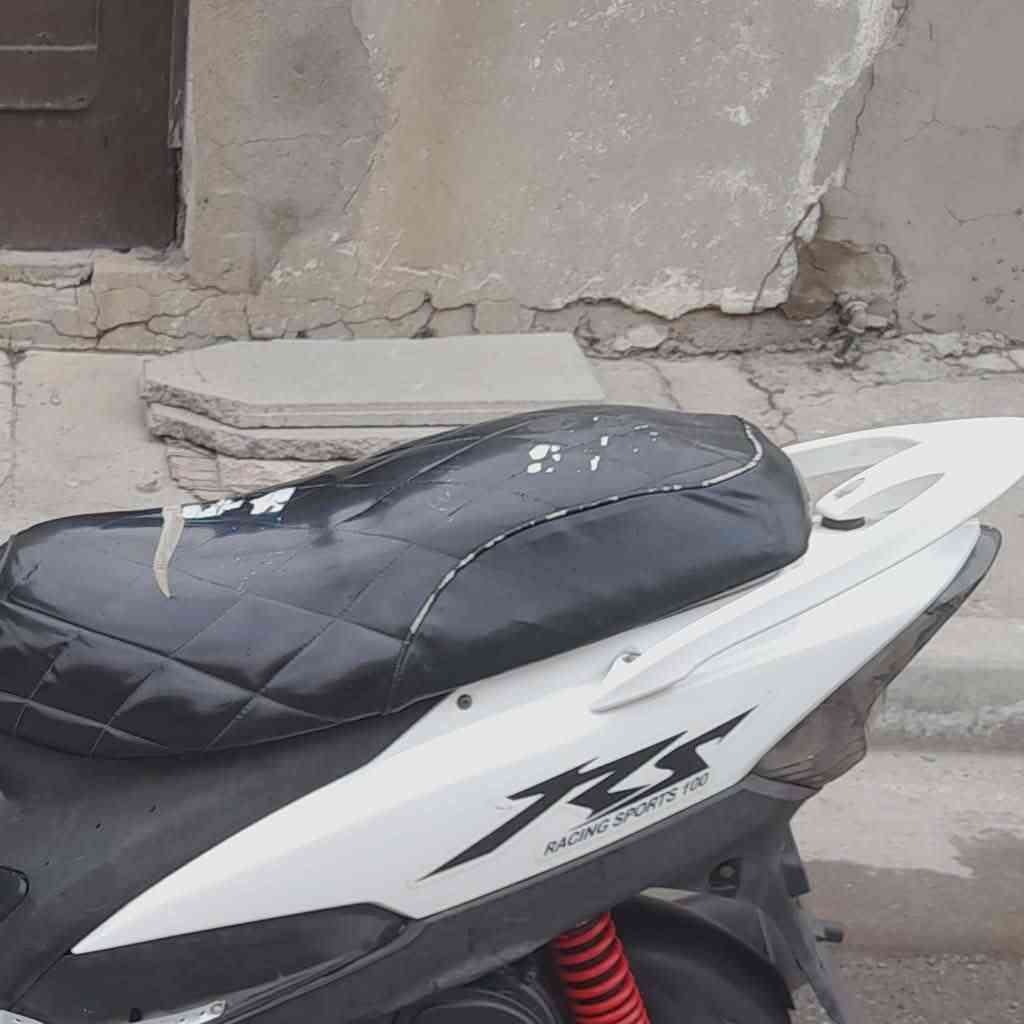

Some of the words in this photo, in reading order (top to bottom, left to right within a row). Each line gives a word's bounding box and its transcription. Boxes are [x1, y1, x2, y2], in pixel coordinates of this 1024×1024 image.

[544, 818, 610, 856] RACING
[612, 787, 679, 828] SPORTS
[681, 772, 710, 795] 100
